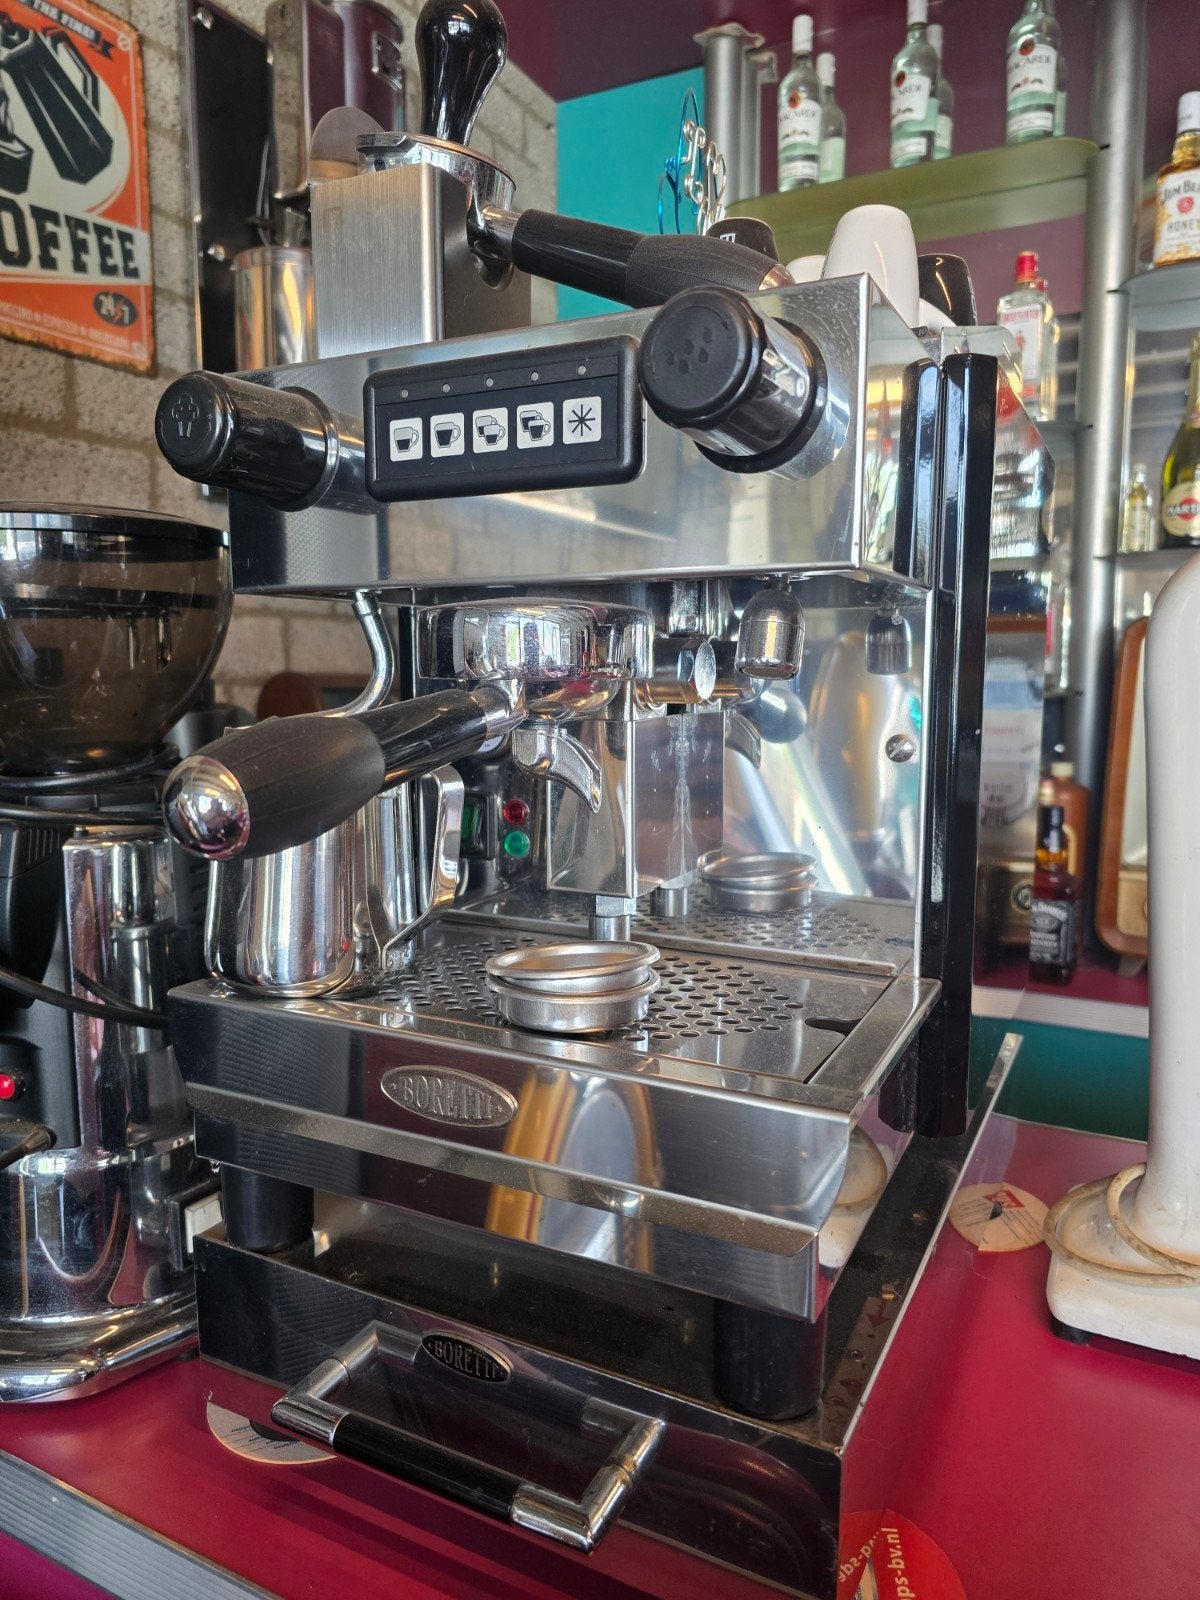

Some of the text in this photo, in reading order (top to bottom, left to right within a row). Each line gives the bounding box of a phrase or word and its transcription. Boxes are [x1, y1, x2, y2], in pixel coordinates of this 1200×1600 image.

[403, 1075, 492, 1120] BORETTI
[434, 1340, 499, 1379] BORETTI
[880, 1527, 916, 1600] ps-bv.nl
